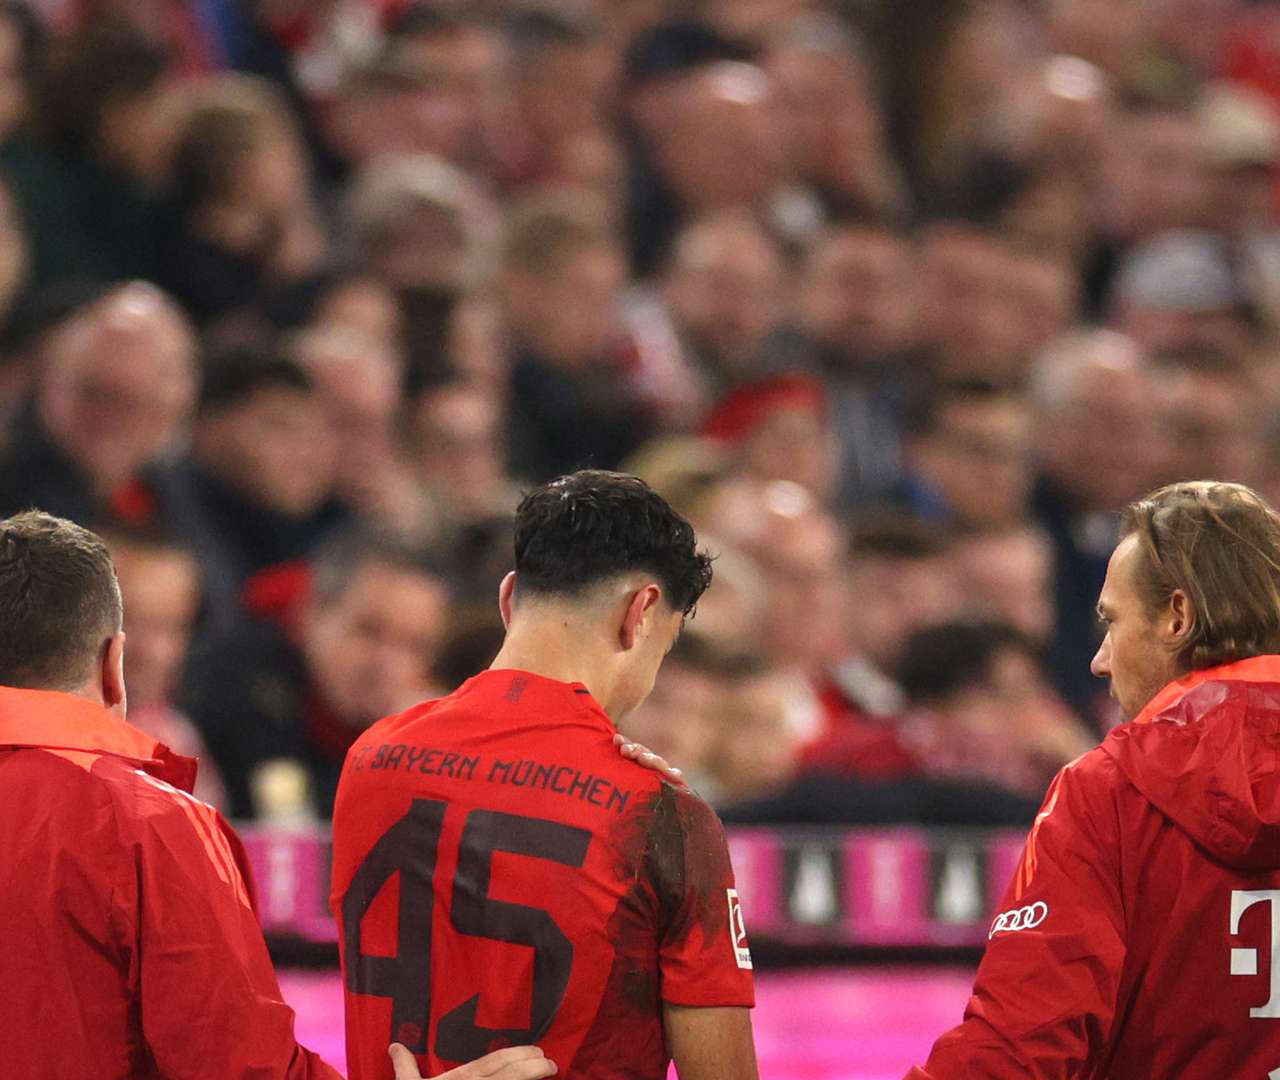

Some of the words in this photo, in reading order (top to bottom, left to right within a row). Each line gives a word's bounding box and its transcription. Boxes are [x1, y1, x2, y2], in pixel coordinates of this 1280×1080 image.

[372, 743, 480, 783] BAYERN
[487, 760, 631, 814] MÜNCHEN
[341, 797, 593, 1064] 45
